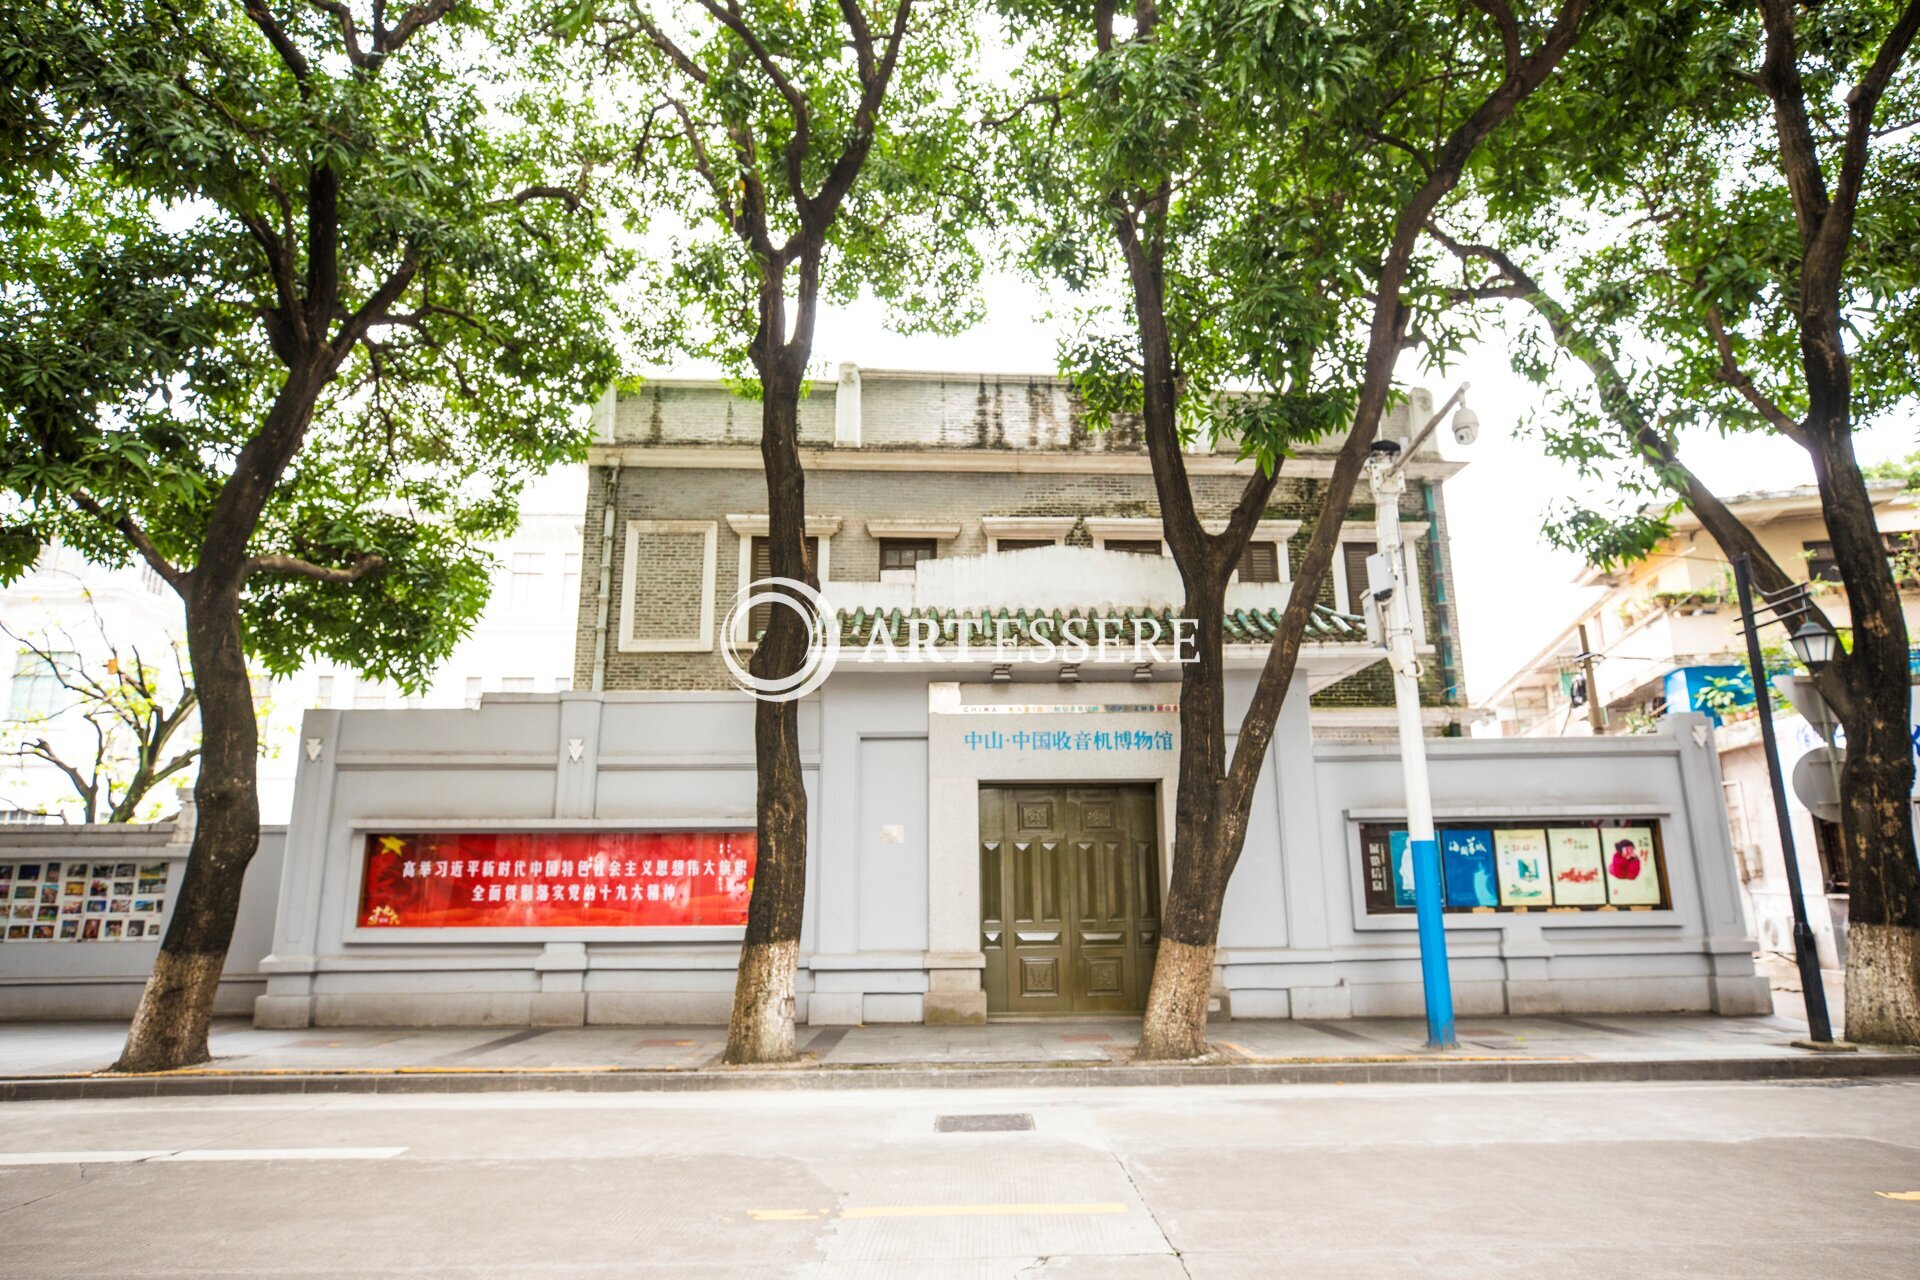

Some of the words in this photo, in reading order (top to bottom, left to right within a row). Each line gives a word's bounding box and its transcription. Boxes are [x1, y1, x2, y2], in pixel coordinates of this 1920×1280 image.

[1008, 705, 1043, 713] RADIO
[964, 730, 1173, 751] 中山·中国收音机博物馆
[402, 859, 748, 878] 高举习近平新时代中国特色社会主义思想伟大旗帜
[471, 883, 676, 902] 全面贯彻落实党的十九大精神
